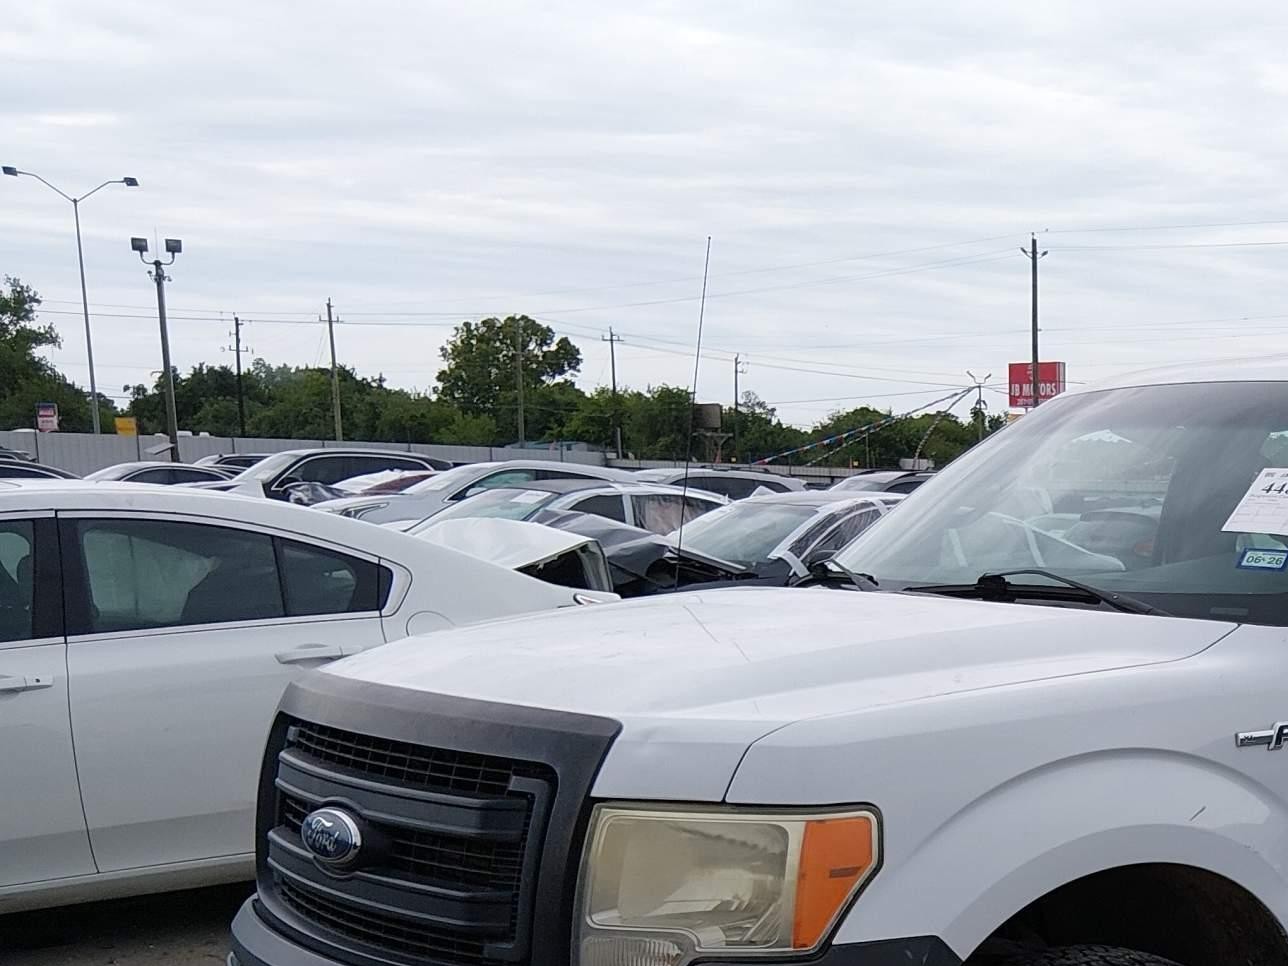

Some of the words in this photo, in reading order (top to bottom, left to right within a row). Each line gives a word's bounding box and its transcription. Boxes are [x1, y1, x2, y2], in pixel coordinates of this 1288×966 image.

[1022, 383, 1057, 396] MORS
[1246, 555, 1262, 564] 06
[1267, 556, 1284, 566] 26
[307, 816, 340, 851] Ford
